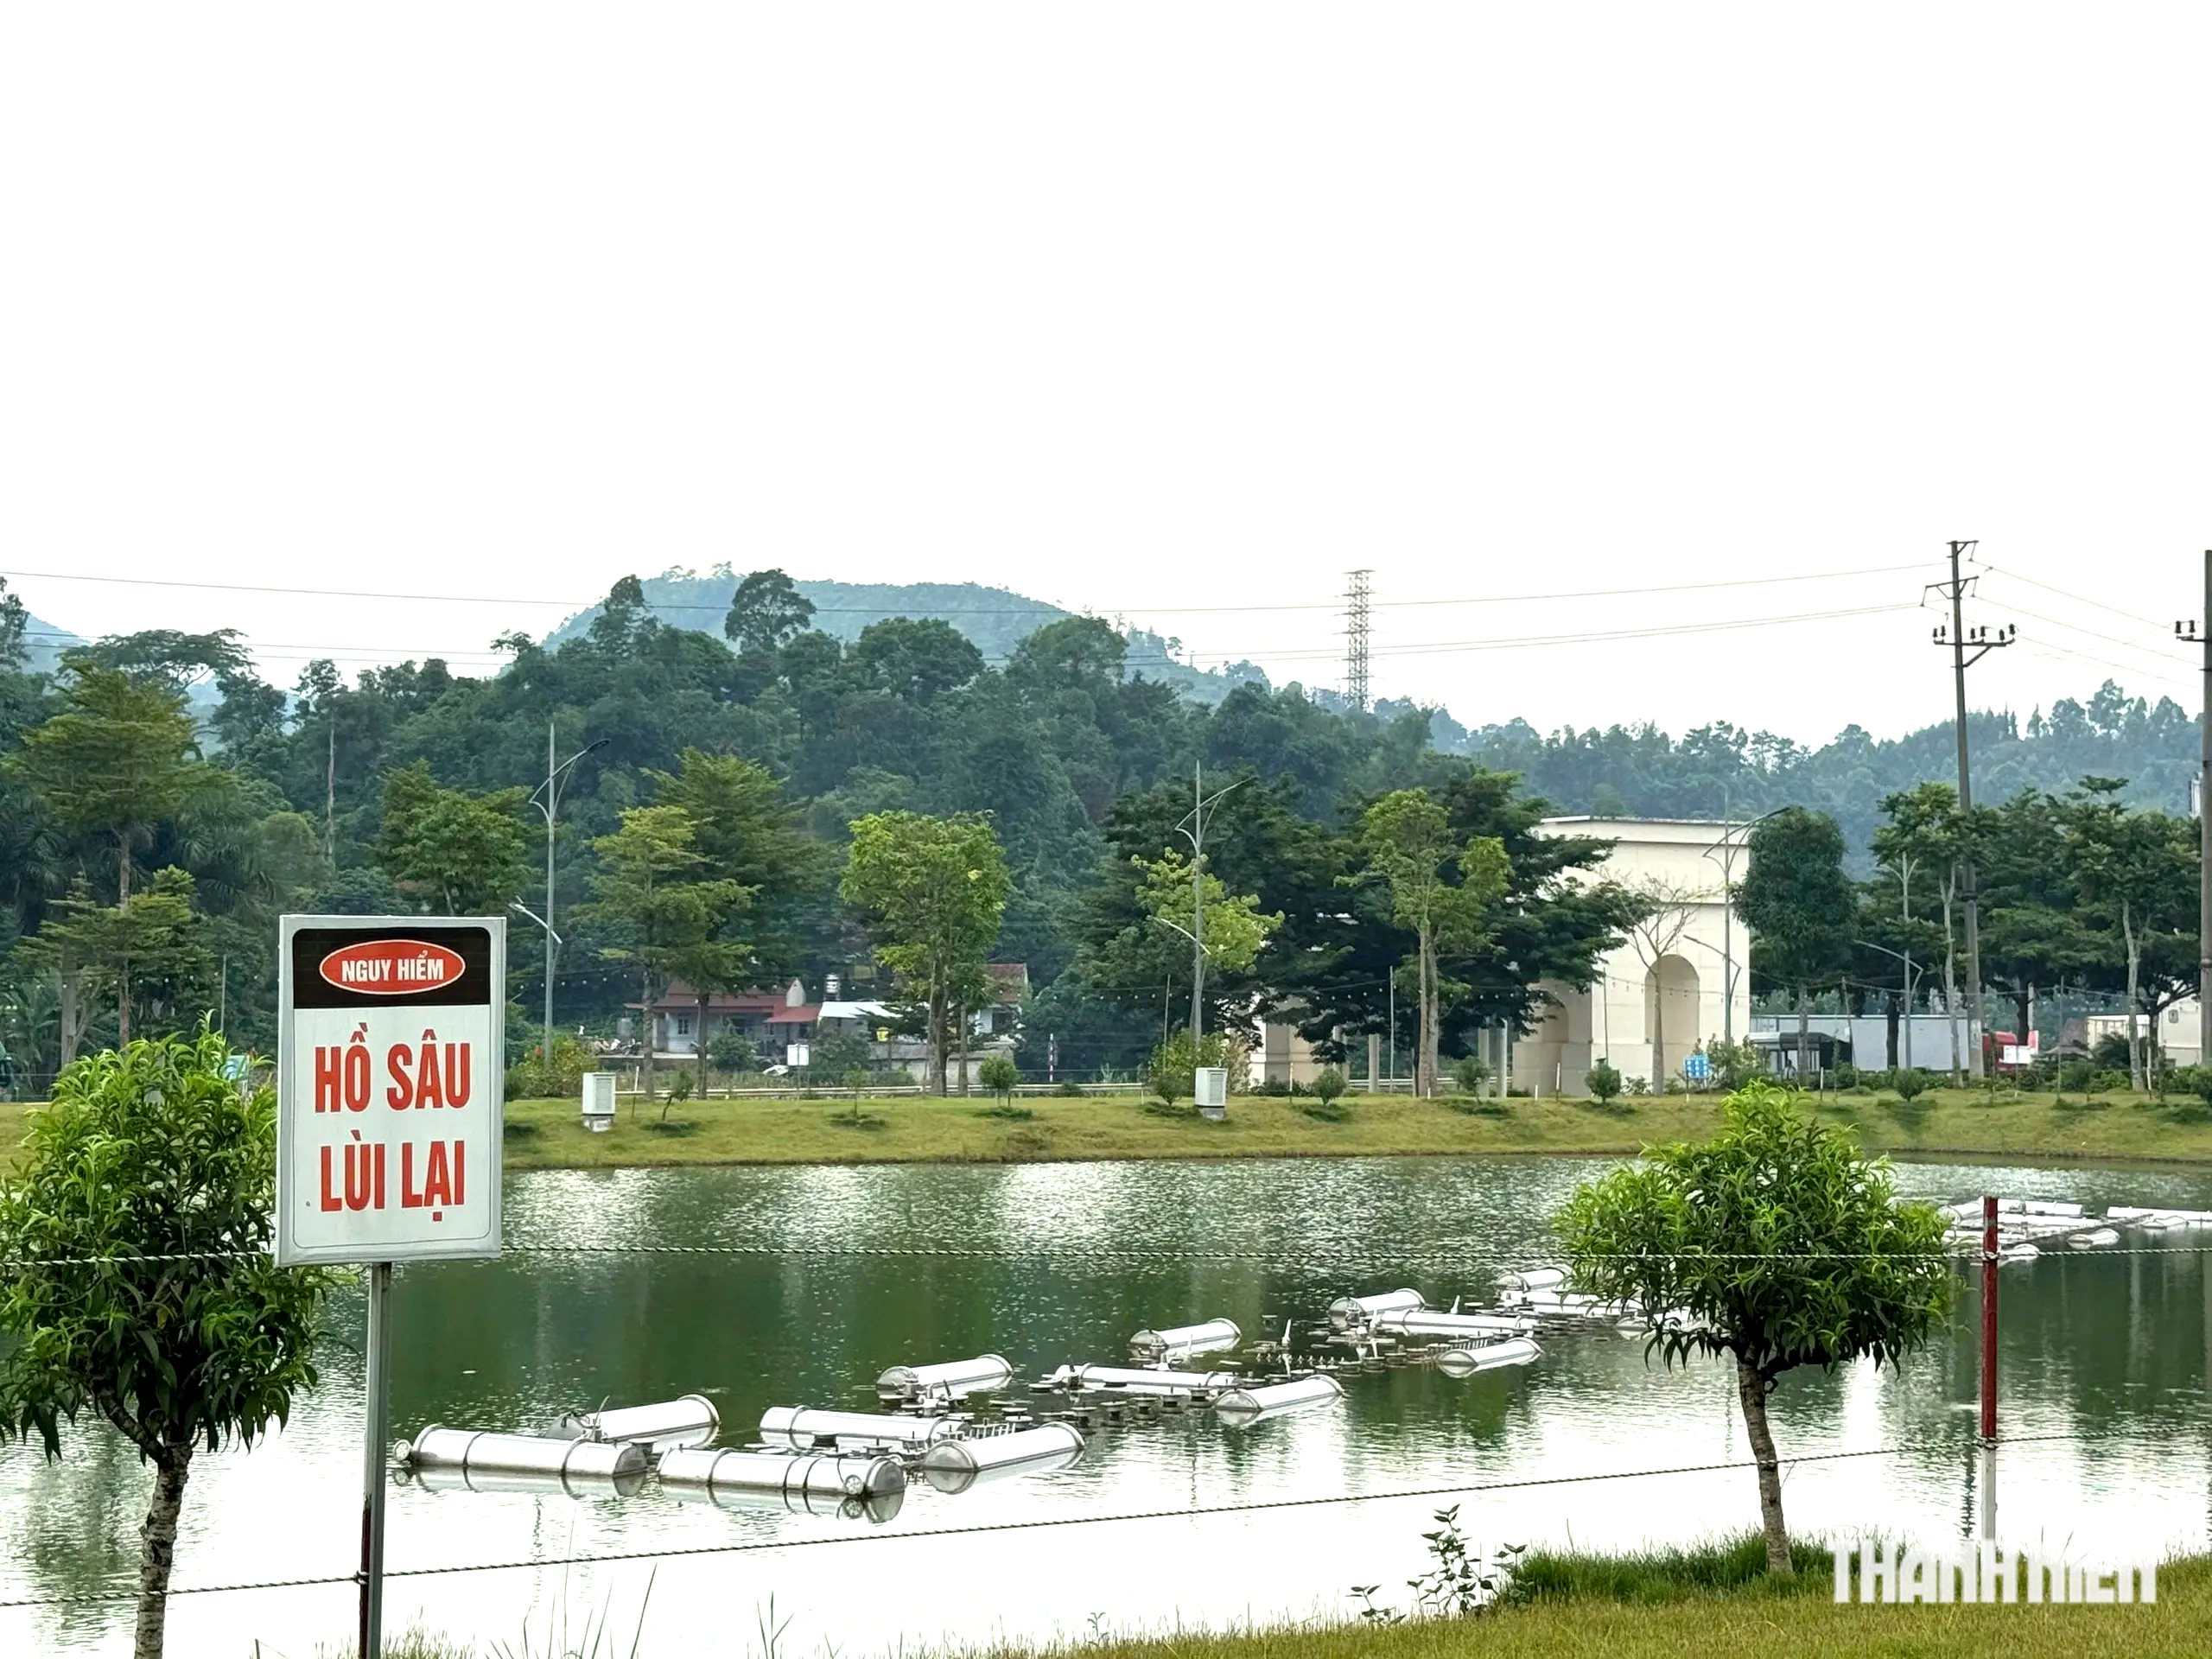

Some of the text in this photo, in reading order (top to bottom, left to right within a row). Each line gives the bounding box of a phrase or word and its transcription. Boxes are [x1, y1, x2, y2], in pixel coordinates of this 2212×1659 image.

[341, 949, 444, 982] NGUY HIỂM
[315, 1021, 471, 1113] HỒ SÂU
[320, 1128, 465, 1222] LÙI LẠI
